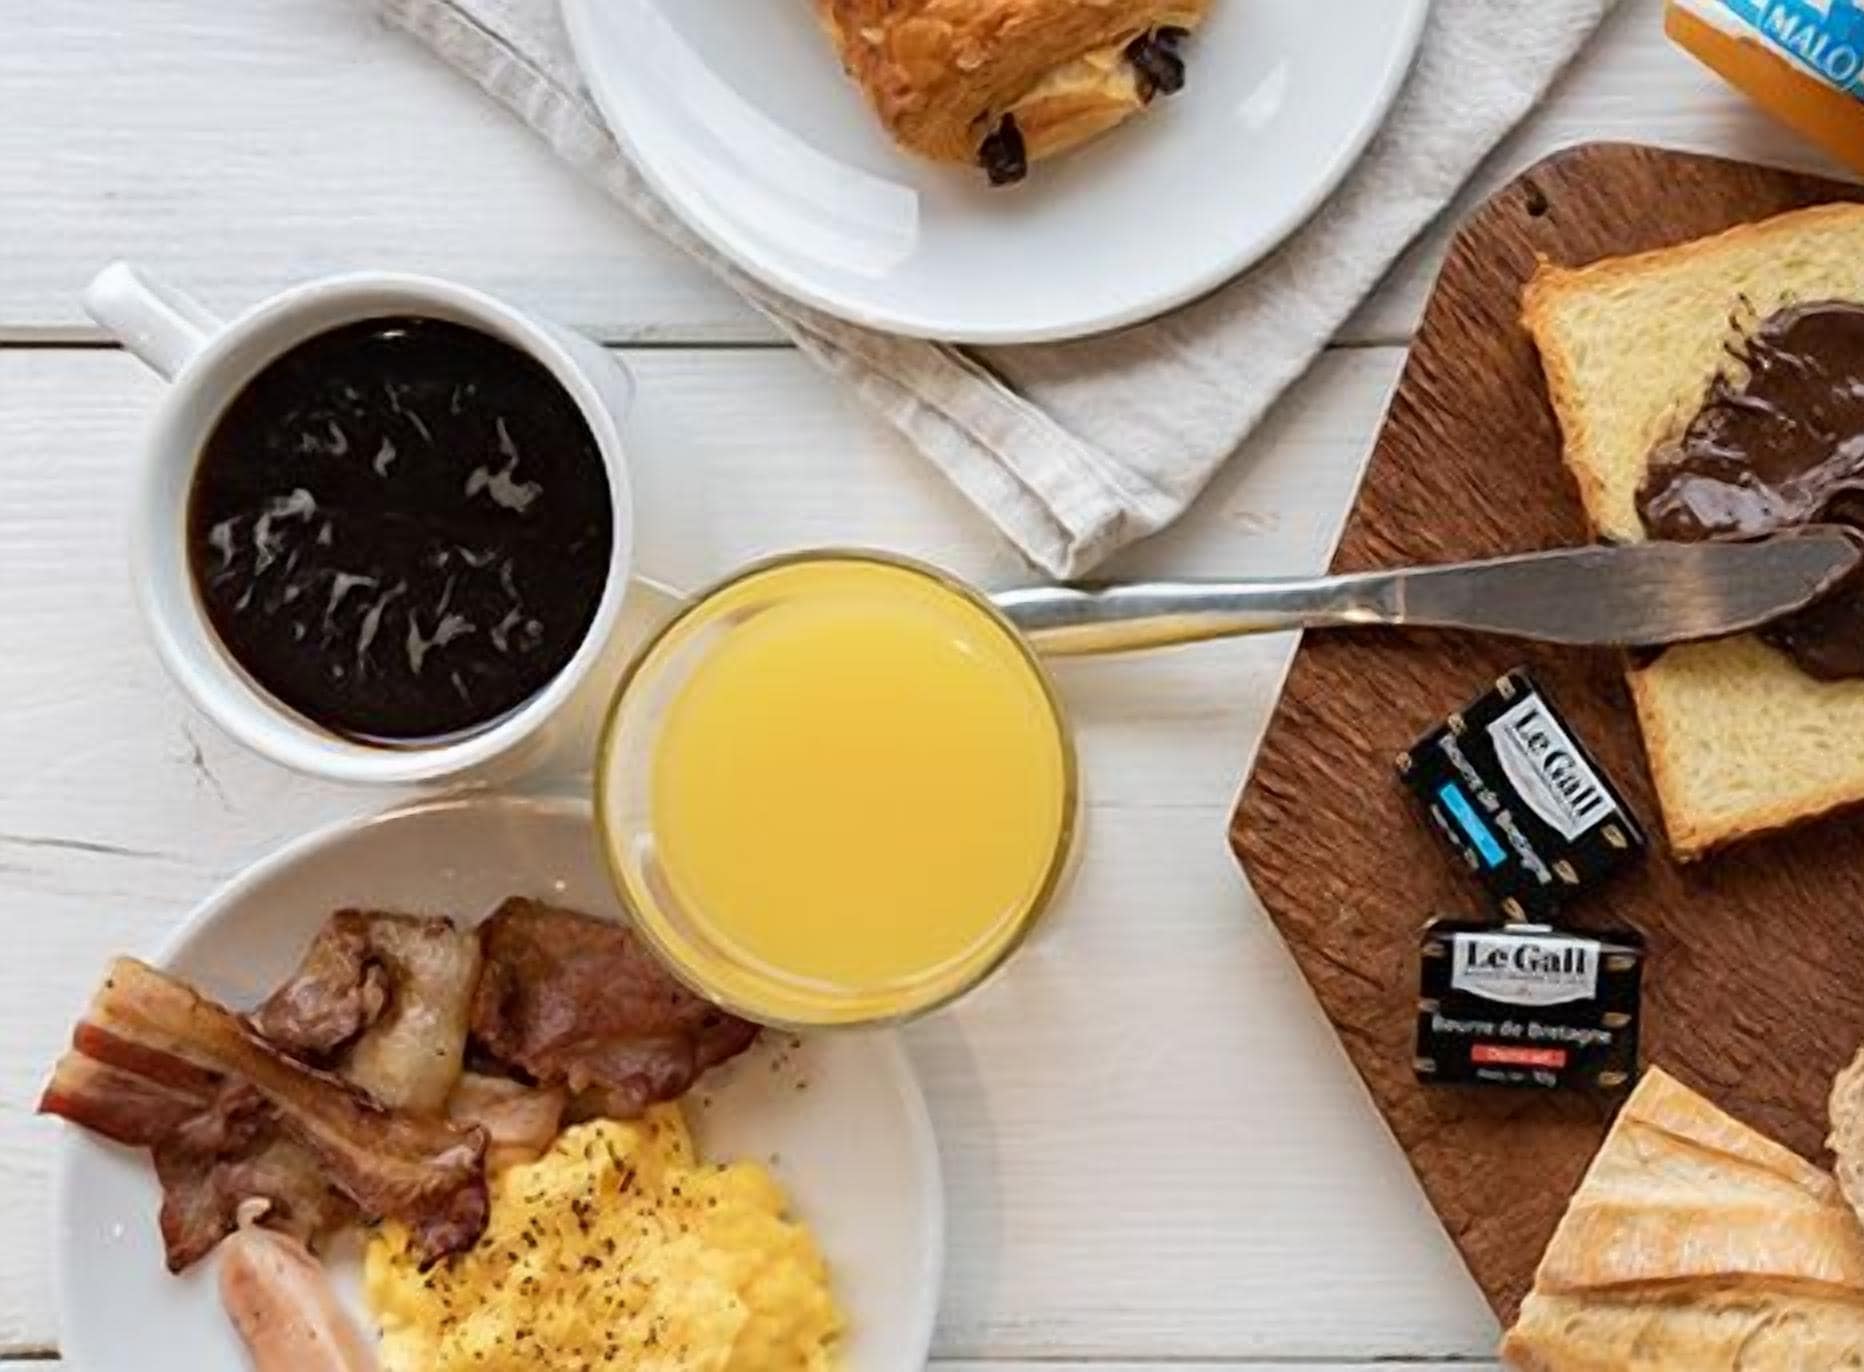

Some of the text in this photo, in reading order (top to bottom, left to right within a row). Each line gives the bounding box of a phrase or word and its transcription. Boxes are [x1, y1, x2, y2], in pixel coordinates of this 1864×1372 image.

[1762, 3, 1857, 82] MALO
[1515, 708, 1550, 752] Le
[1542, 749, 1602, 817] Gall
[1466, 940, 1586, 975] Le Gall
